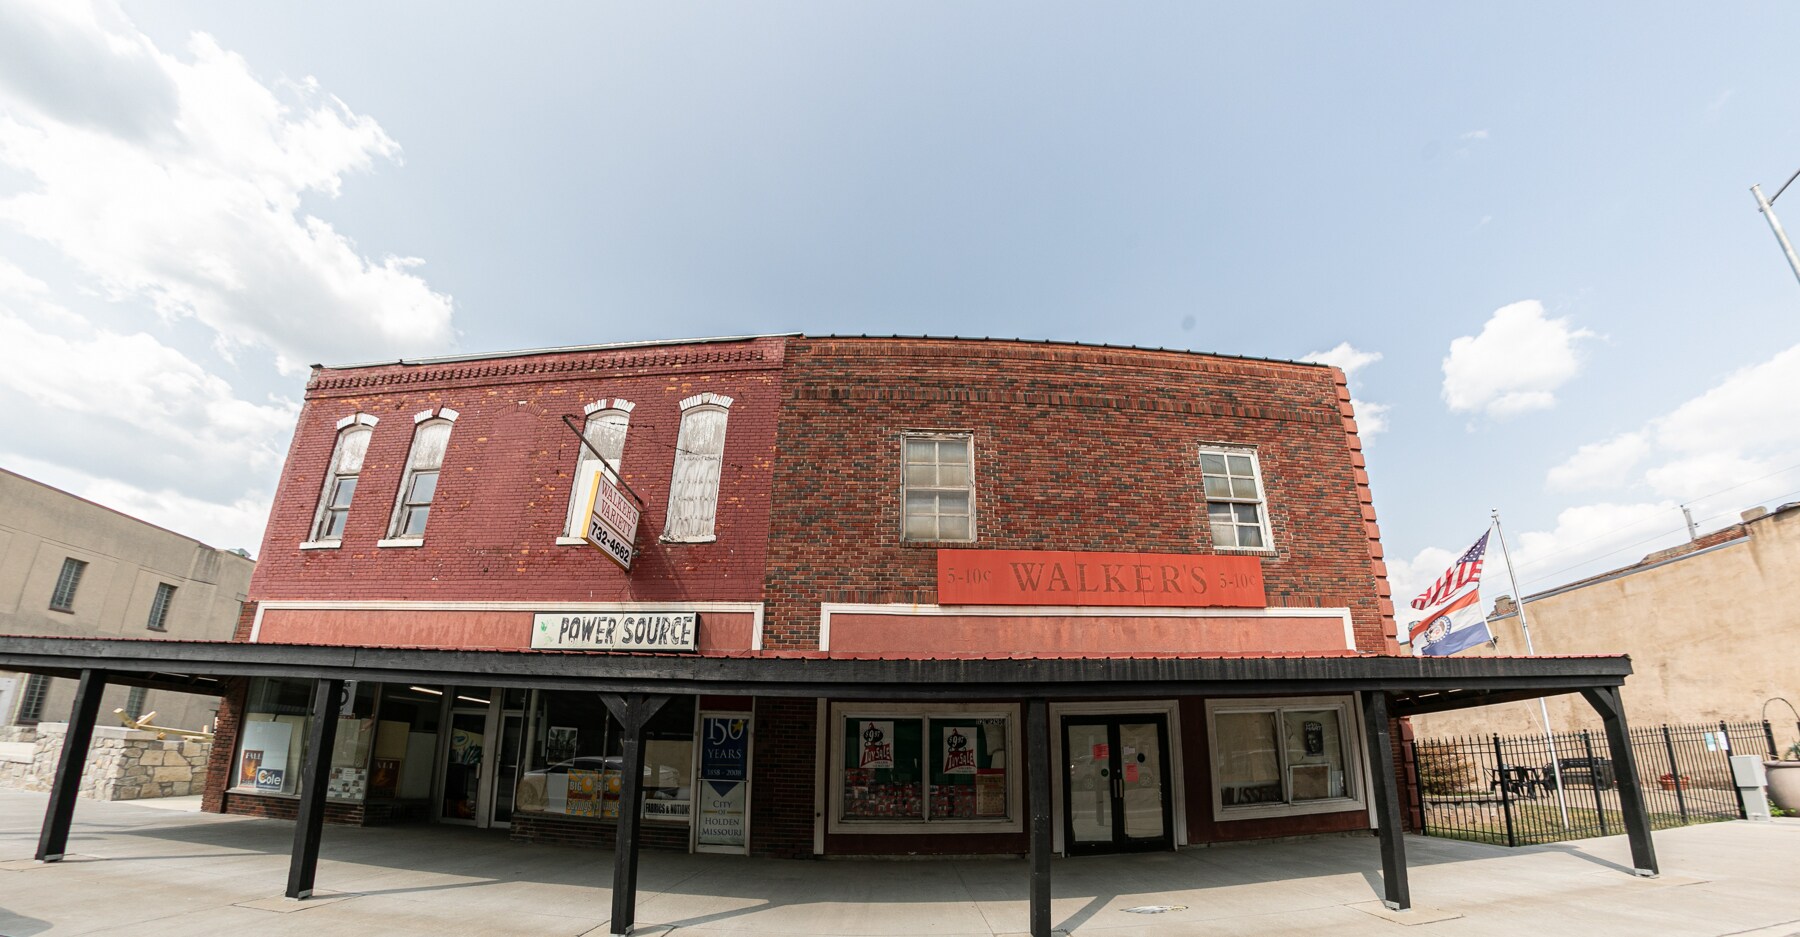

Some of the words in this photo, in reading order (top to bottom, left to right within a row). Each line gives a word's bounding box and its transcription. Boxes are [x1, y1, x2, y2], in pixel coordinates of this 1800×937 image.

[602, 480, 637, 525] WALKER'S
[601, 498, 633, 538] VARIETY
[591, 521, 630, 563] 732-4662
[1009, 562, 1208, 594] WALKER'S
[558, 616, 617, 645] POWER
[621, 615, 693, 645] SOURCE
[707, 718, 744, 745] 150
[707, 748, 742, 759] YEARS
[258, 769, 281, 785] Cole
[726, 769, 742, 777] 2008
[569, 780, 582, 791] BIG
[568, 799, 593, 812] Savings
[645, 802, 666, 814] FABRICS
[670, 803, 691, 815] NOTIONS
[713, 800, 733, 808] CITY
[705, 817, 740, 826] HOLDEN
[701, 827, 742, 837] MISSOURI
